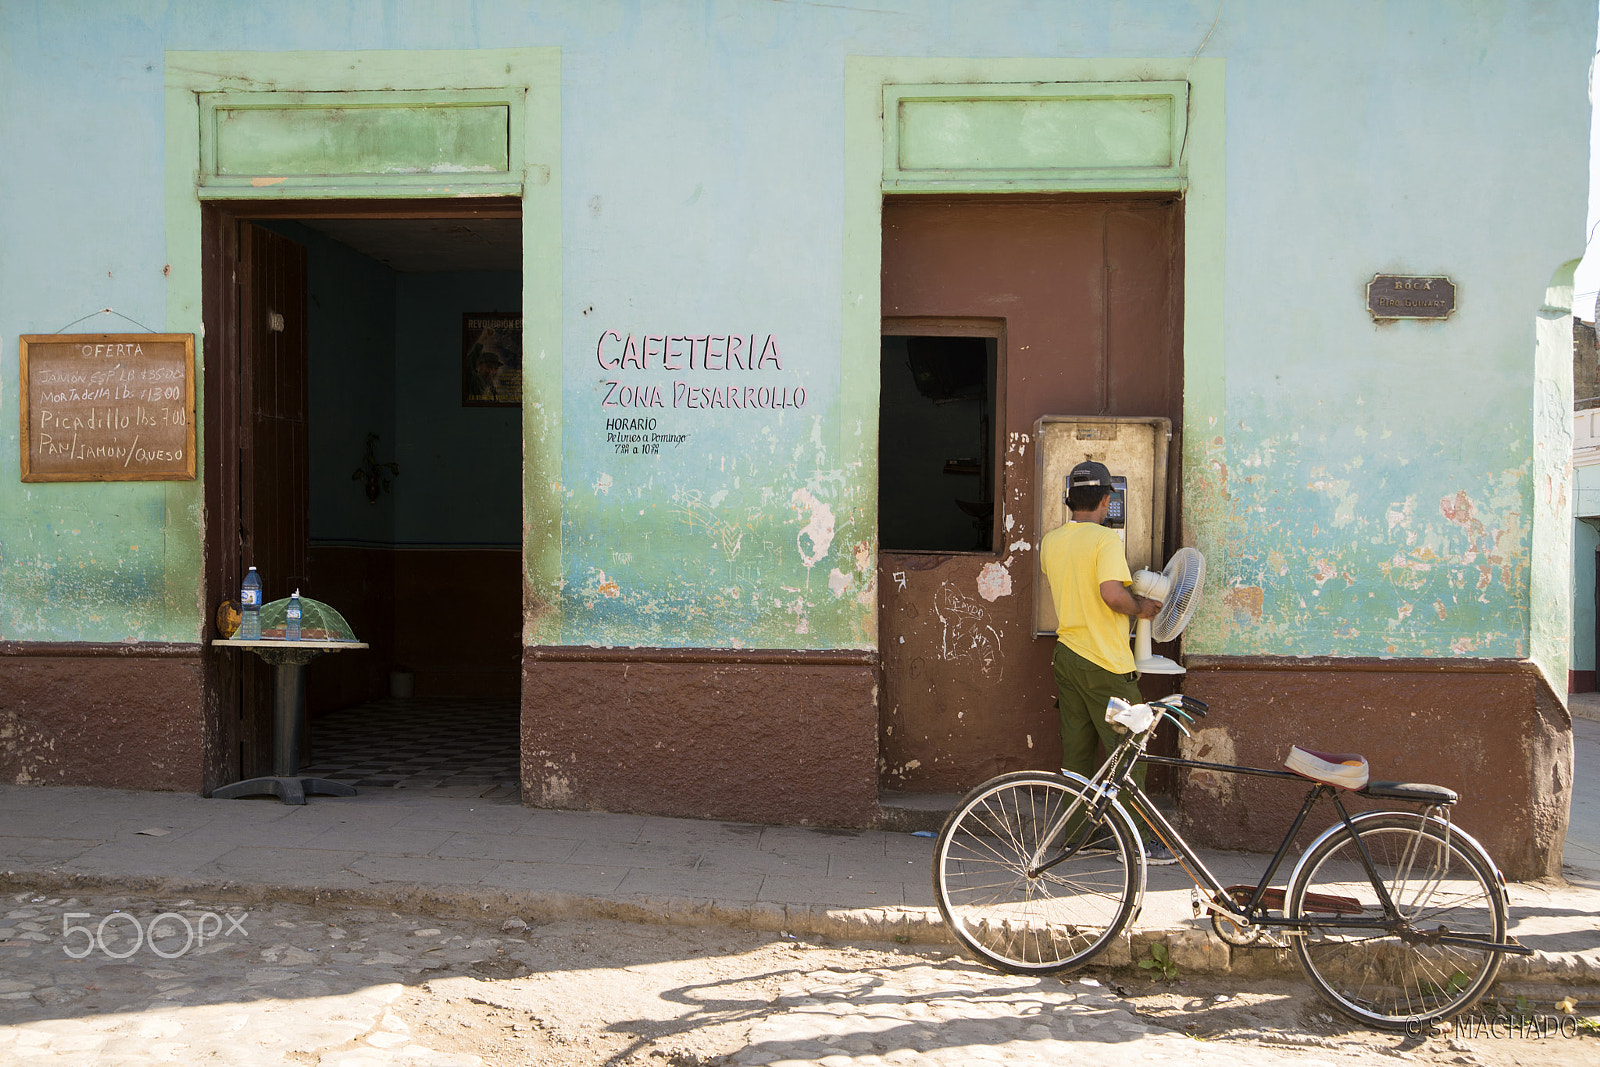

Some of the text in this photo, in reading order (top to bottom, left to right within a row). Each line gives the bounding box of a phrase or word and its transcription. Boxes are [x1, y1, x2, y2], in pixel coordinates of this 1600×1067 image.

[1394, 281, 1431, 291] BOCA
[1405, 298, 1446, 308] GUINART
[82, 343, 144, 358] OFERTA
[596, 328, 784, 371] CAFETERIA
[601, 379, 808, 409] ZONA DESARROLLO
[606, 417, 657, 431] HORARIO
[642, 434, 649, 443] a
[651, 432, 688, 448] Domingo
[632, 446, 639, 454] a
